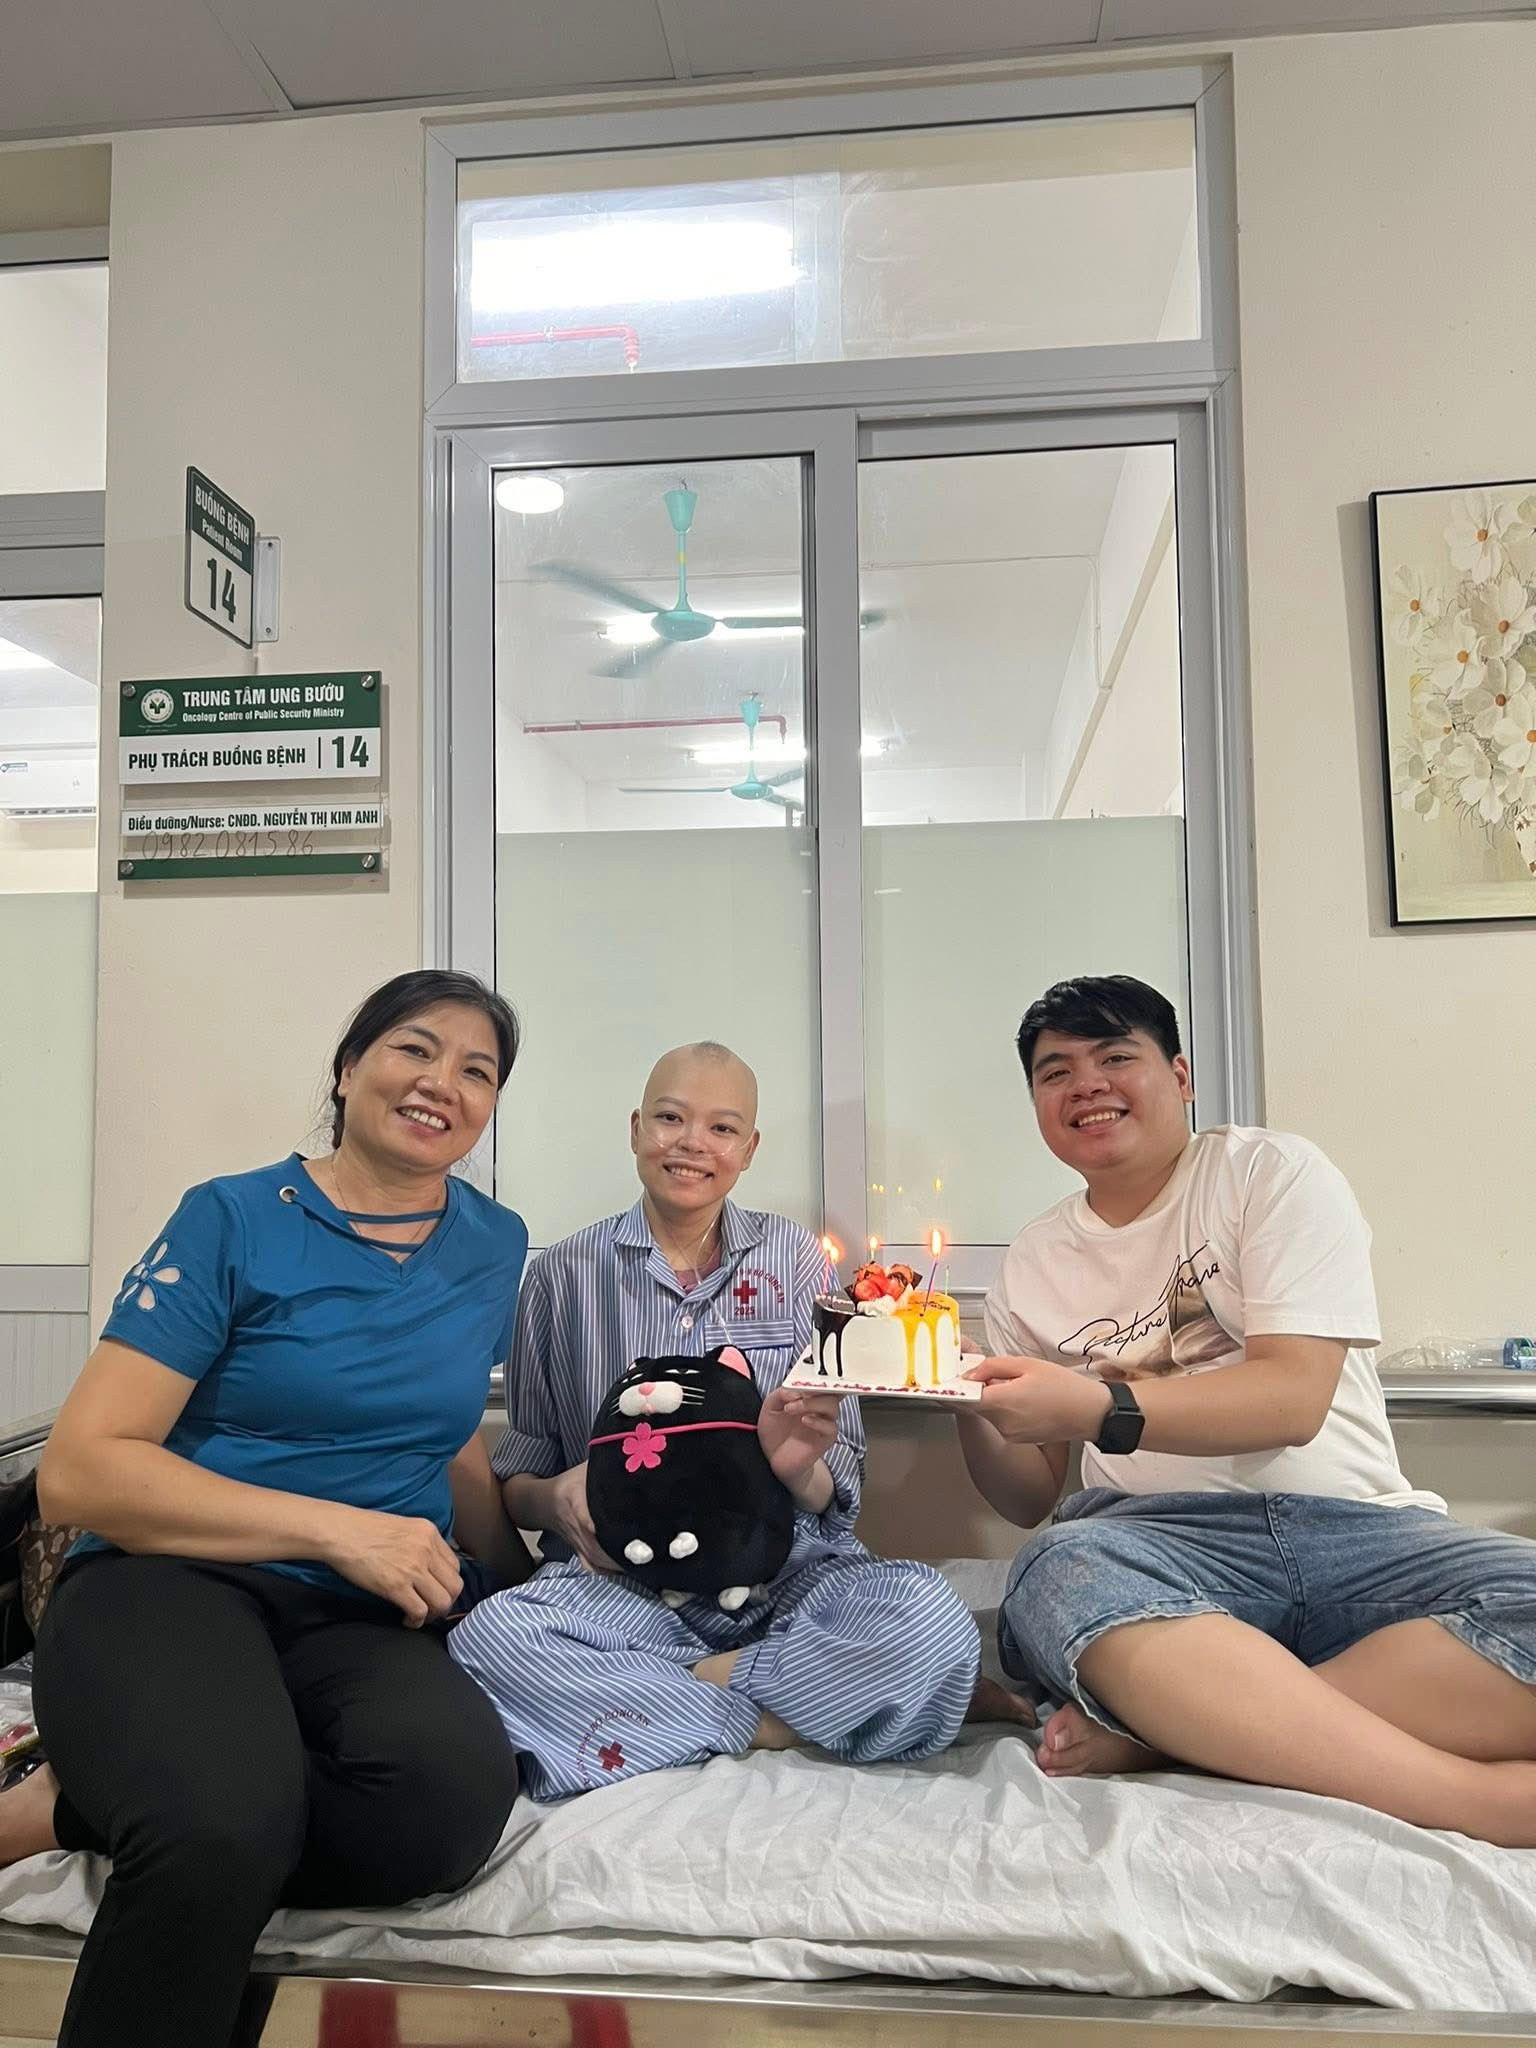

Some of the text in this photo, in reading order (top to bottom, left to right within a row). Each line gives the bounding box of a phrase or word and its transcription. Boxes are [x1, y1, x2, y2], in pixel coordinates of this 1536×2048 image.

[202, 518, 225, 548] Patient
[227, 512, 250, 546] BỆNH
[207, 557, 236, 624] 14
[182, 690, 231, 708] TRUNG
[233, 686, 266, 706] TÂM
[304, 682, 345, 703] BƯỚU
[182, 707, 345, 722] Oncology Centre of Public Security Ministry
[128, 753, 157, 772] PHỤ
[161, 748, 208, 768] TRÁCH
[266, 745, 306, 768] BỆNH
[331, 735, 369, 769] 14
[154, 815, 225, 831] dưỡng/Nurse:
[227, 813, 261, 828] CNĐD.
[263, 807, 307, 827] NGUYỄN
[310, 811, 327, 828] THỊ
[330, 810, 352, 825] KIM
[355, 810, 378, 825] ANH
